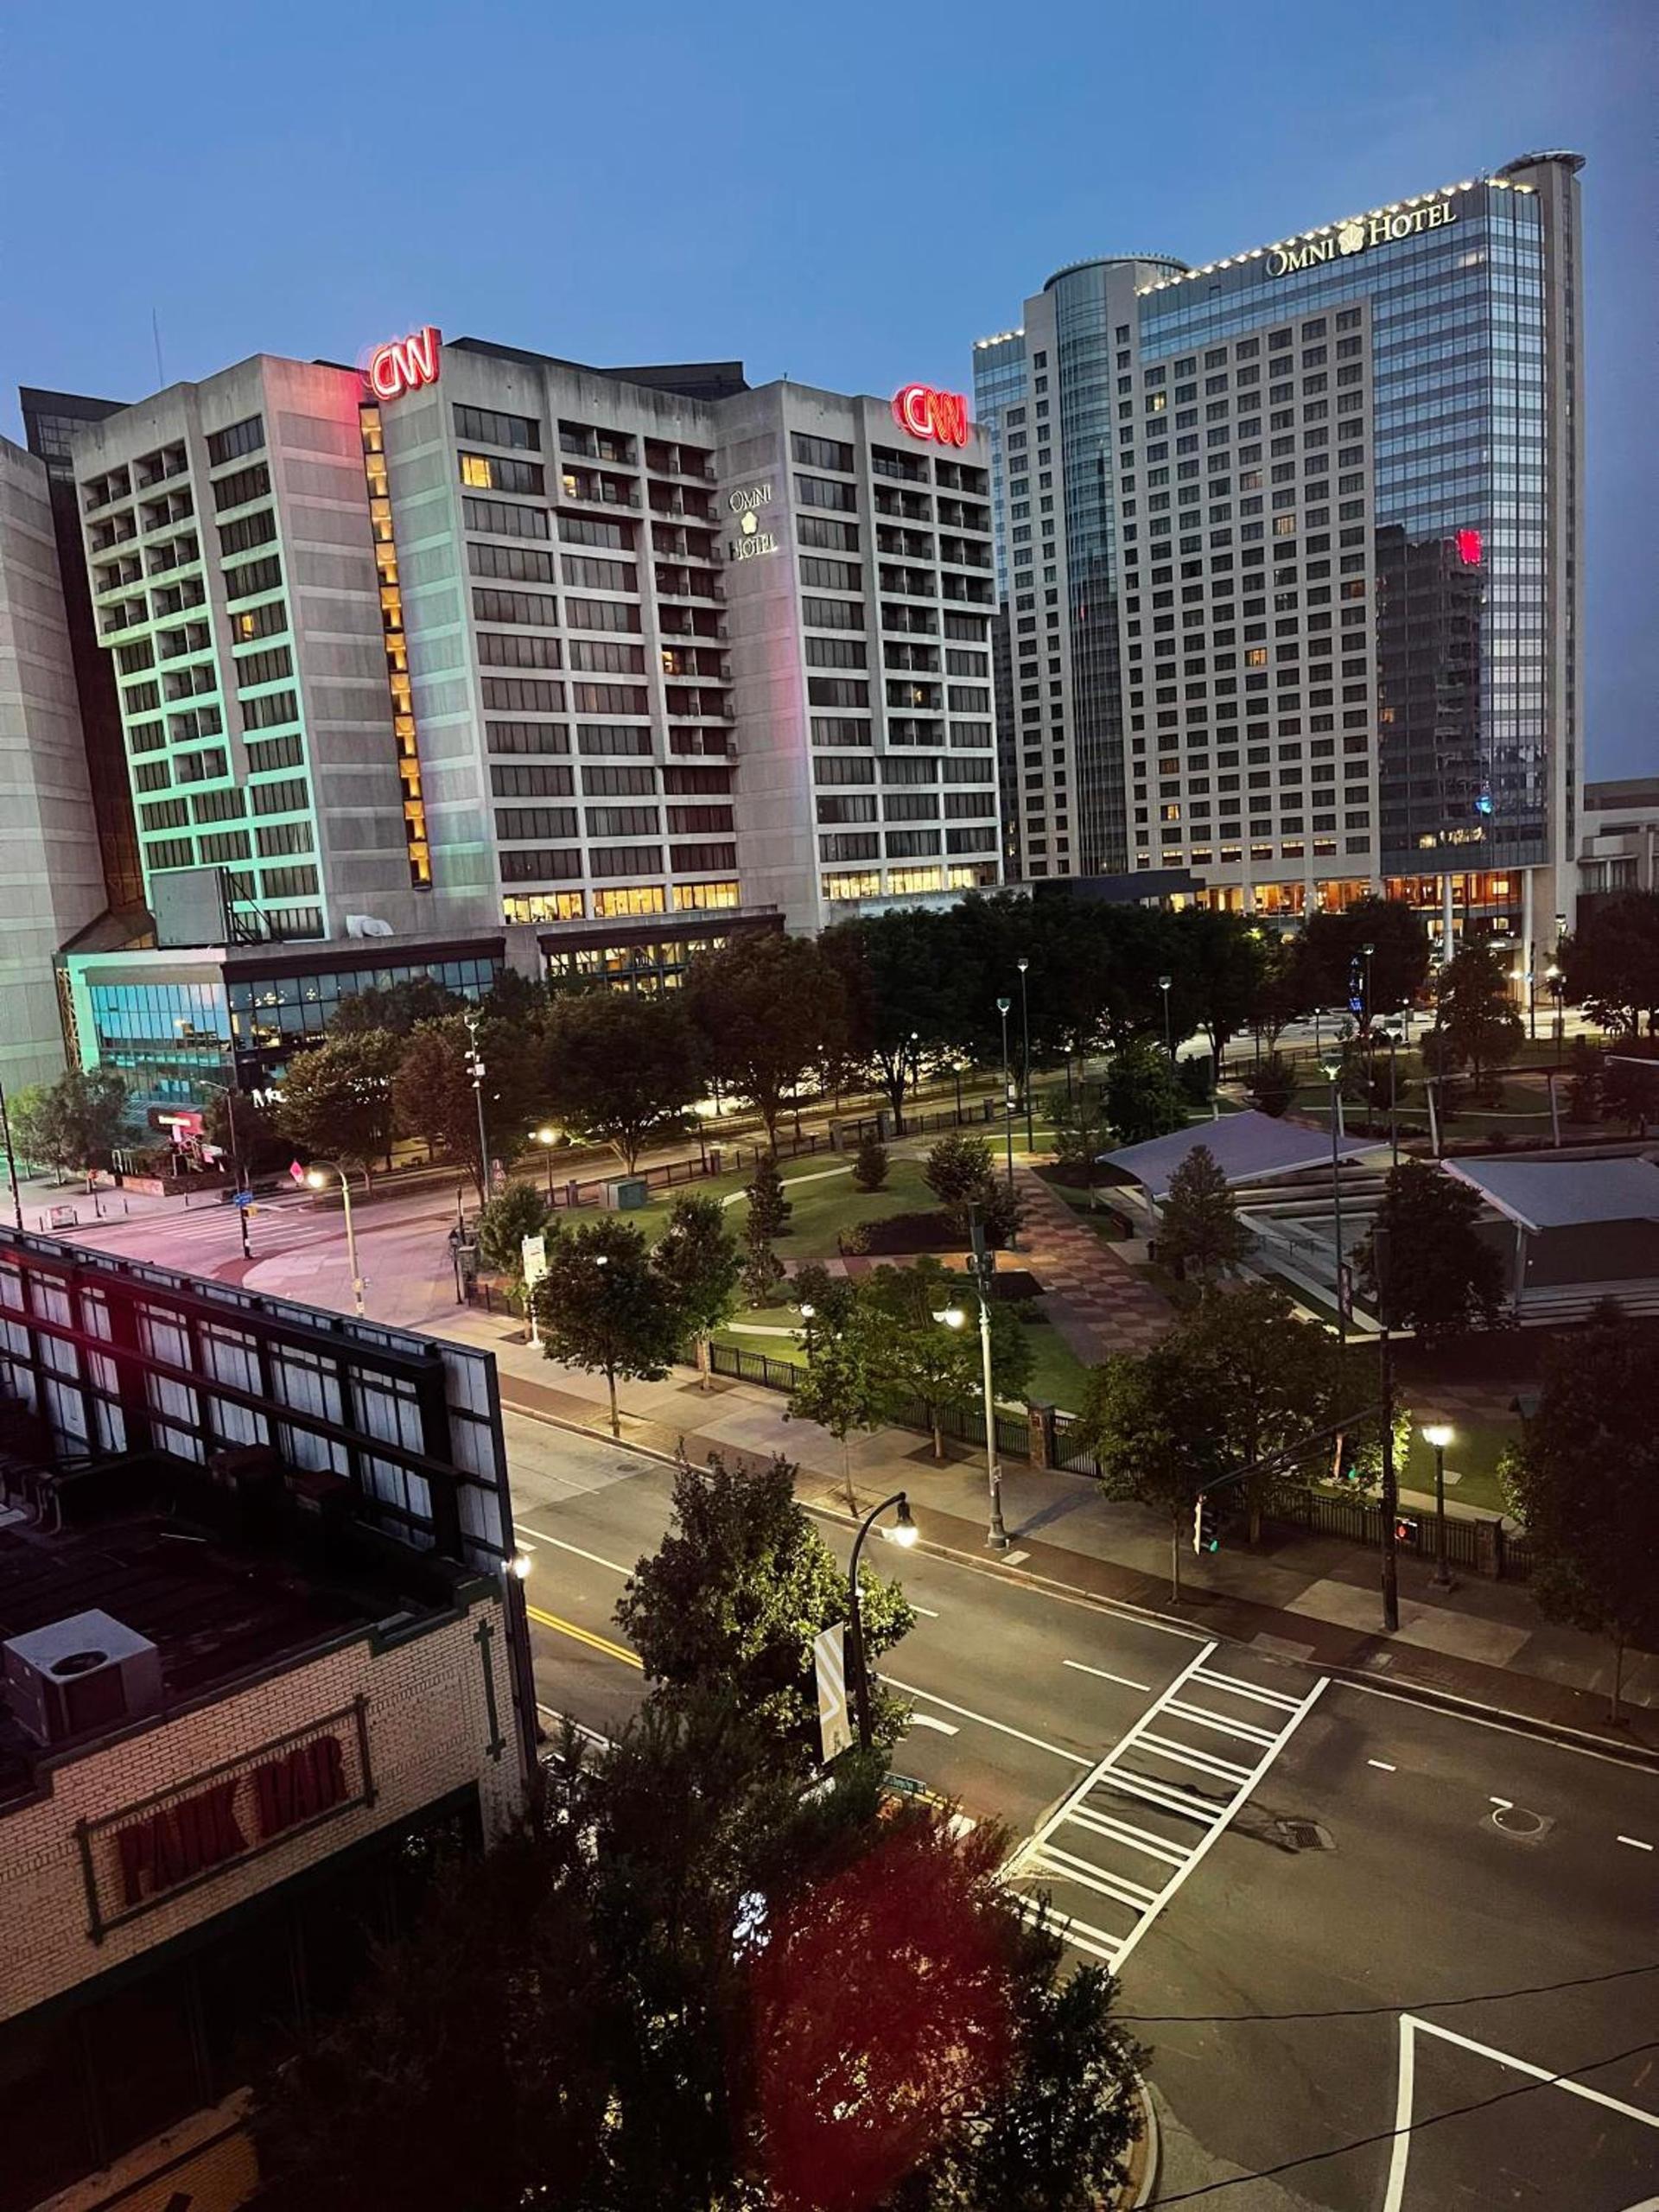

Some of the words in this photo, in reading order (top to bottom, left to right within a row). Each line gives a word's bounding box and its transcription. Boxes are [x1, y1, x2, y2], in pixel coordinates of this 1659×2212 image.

[1265, 238, 1337, 276] OMNI
[1369, 201, 1457, 246] HOTEL
[371, 326, 441, 400] CNN
[893, 385, 967, 447] CNN
[729, 484, 772, 513] OMNI
[728, 533, 778, 561] HOTEL
[118, 1777, 250, 1906] PARK
[257, 1736, 348, 1838] BAR
